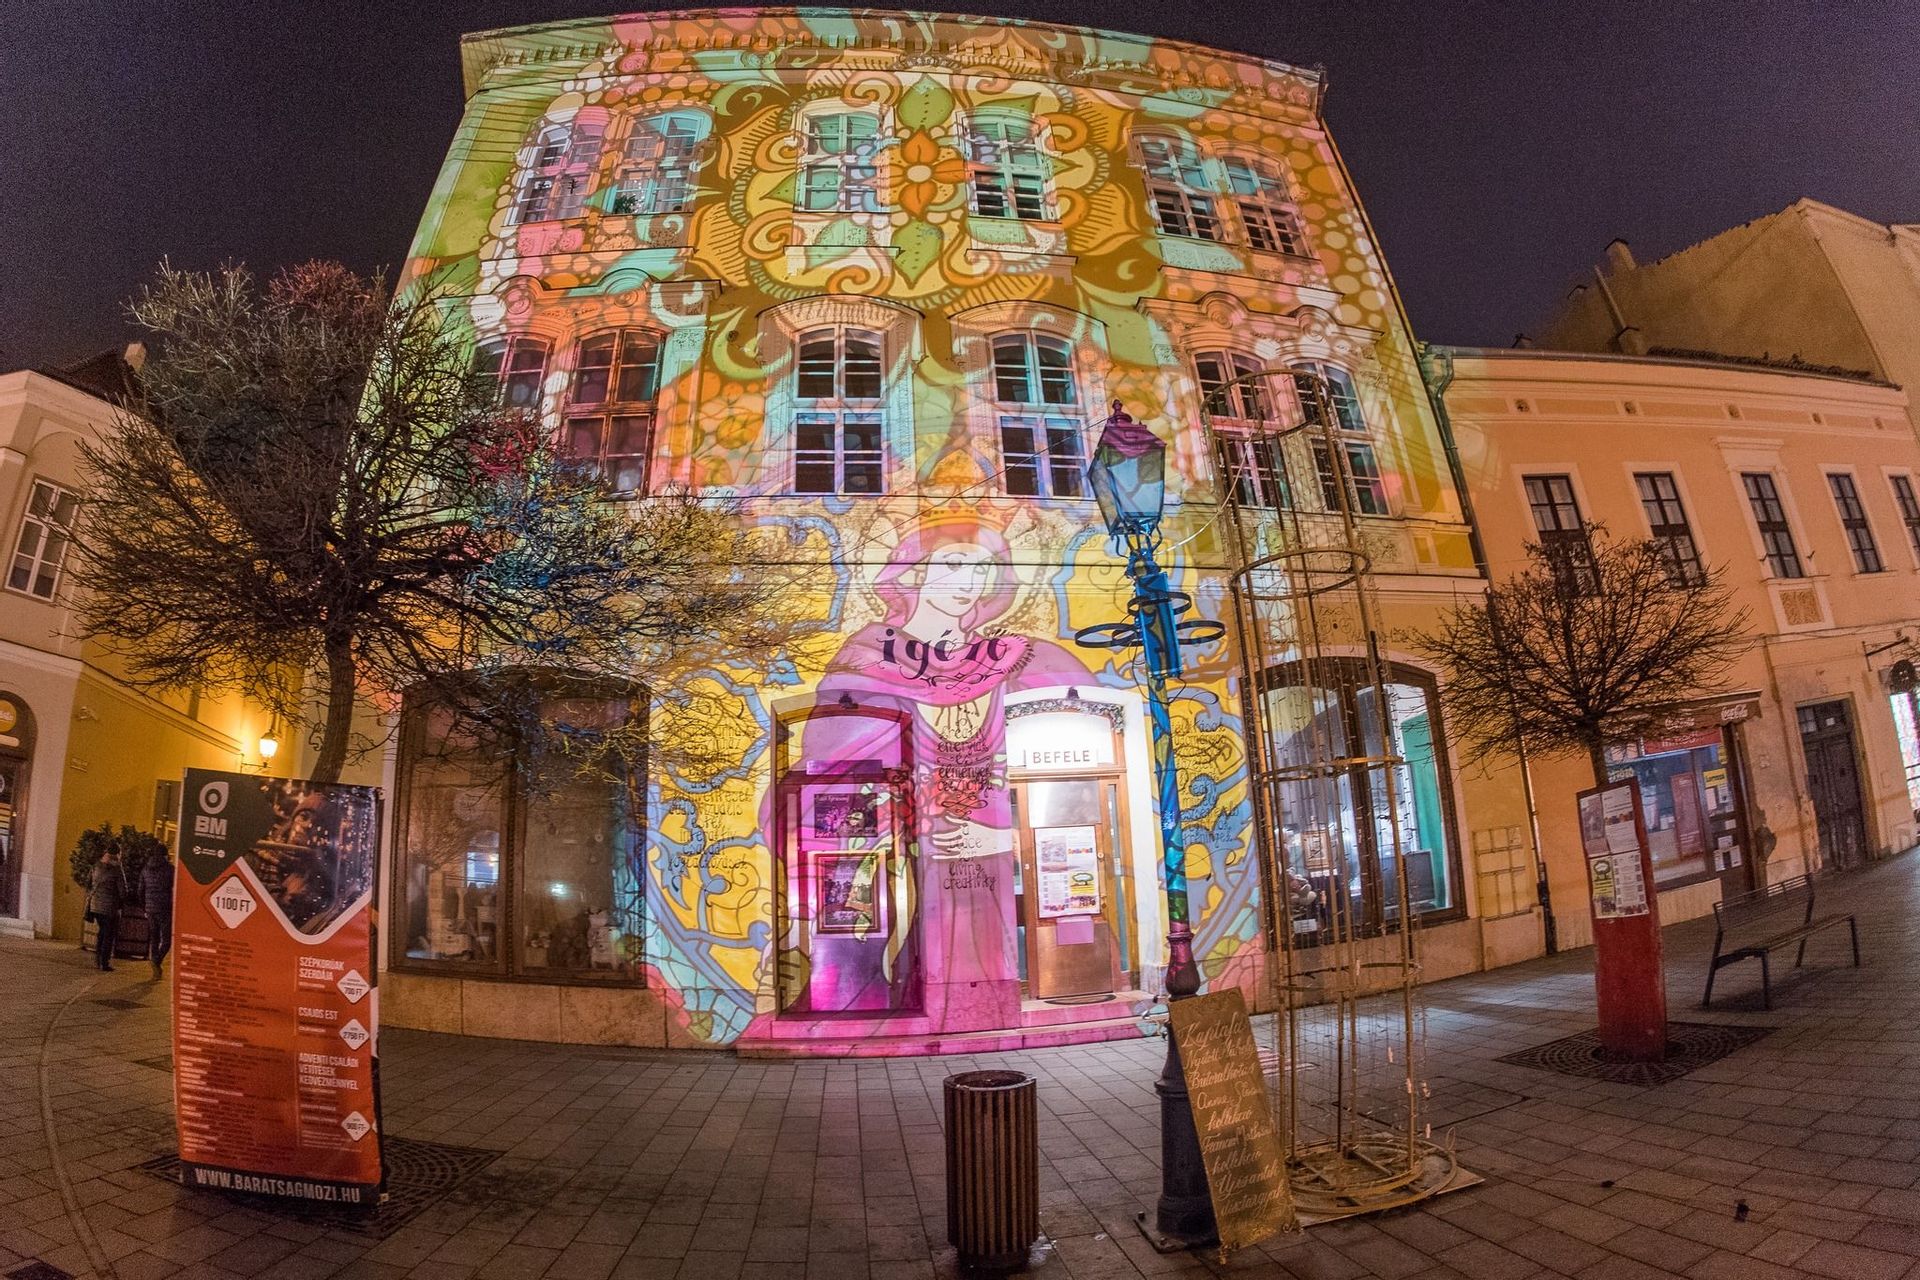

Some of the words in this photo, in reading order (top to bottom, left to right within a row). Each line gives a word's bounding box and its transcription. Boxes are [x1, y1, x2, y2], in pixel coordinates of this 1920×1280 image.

[1033, 750, 1090, 764] BEFELE
[195, 815, 228, 835] BM
[216, 896, 237, 911] 1100
[240, 900, 251, 913] FT
[325, 1010, 338, 1020] EST
[195, 1168, 361, 1203] WWW.BARATSAGMOZI.HU
